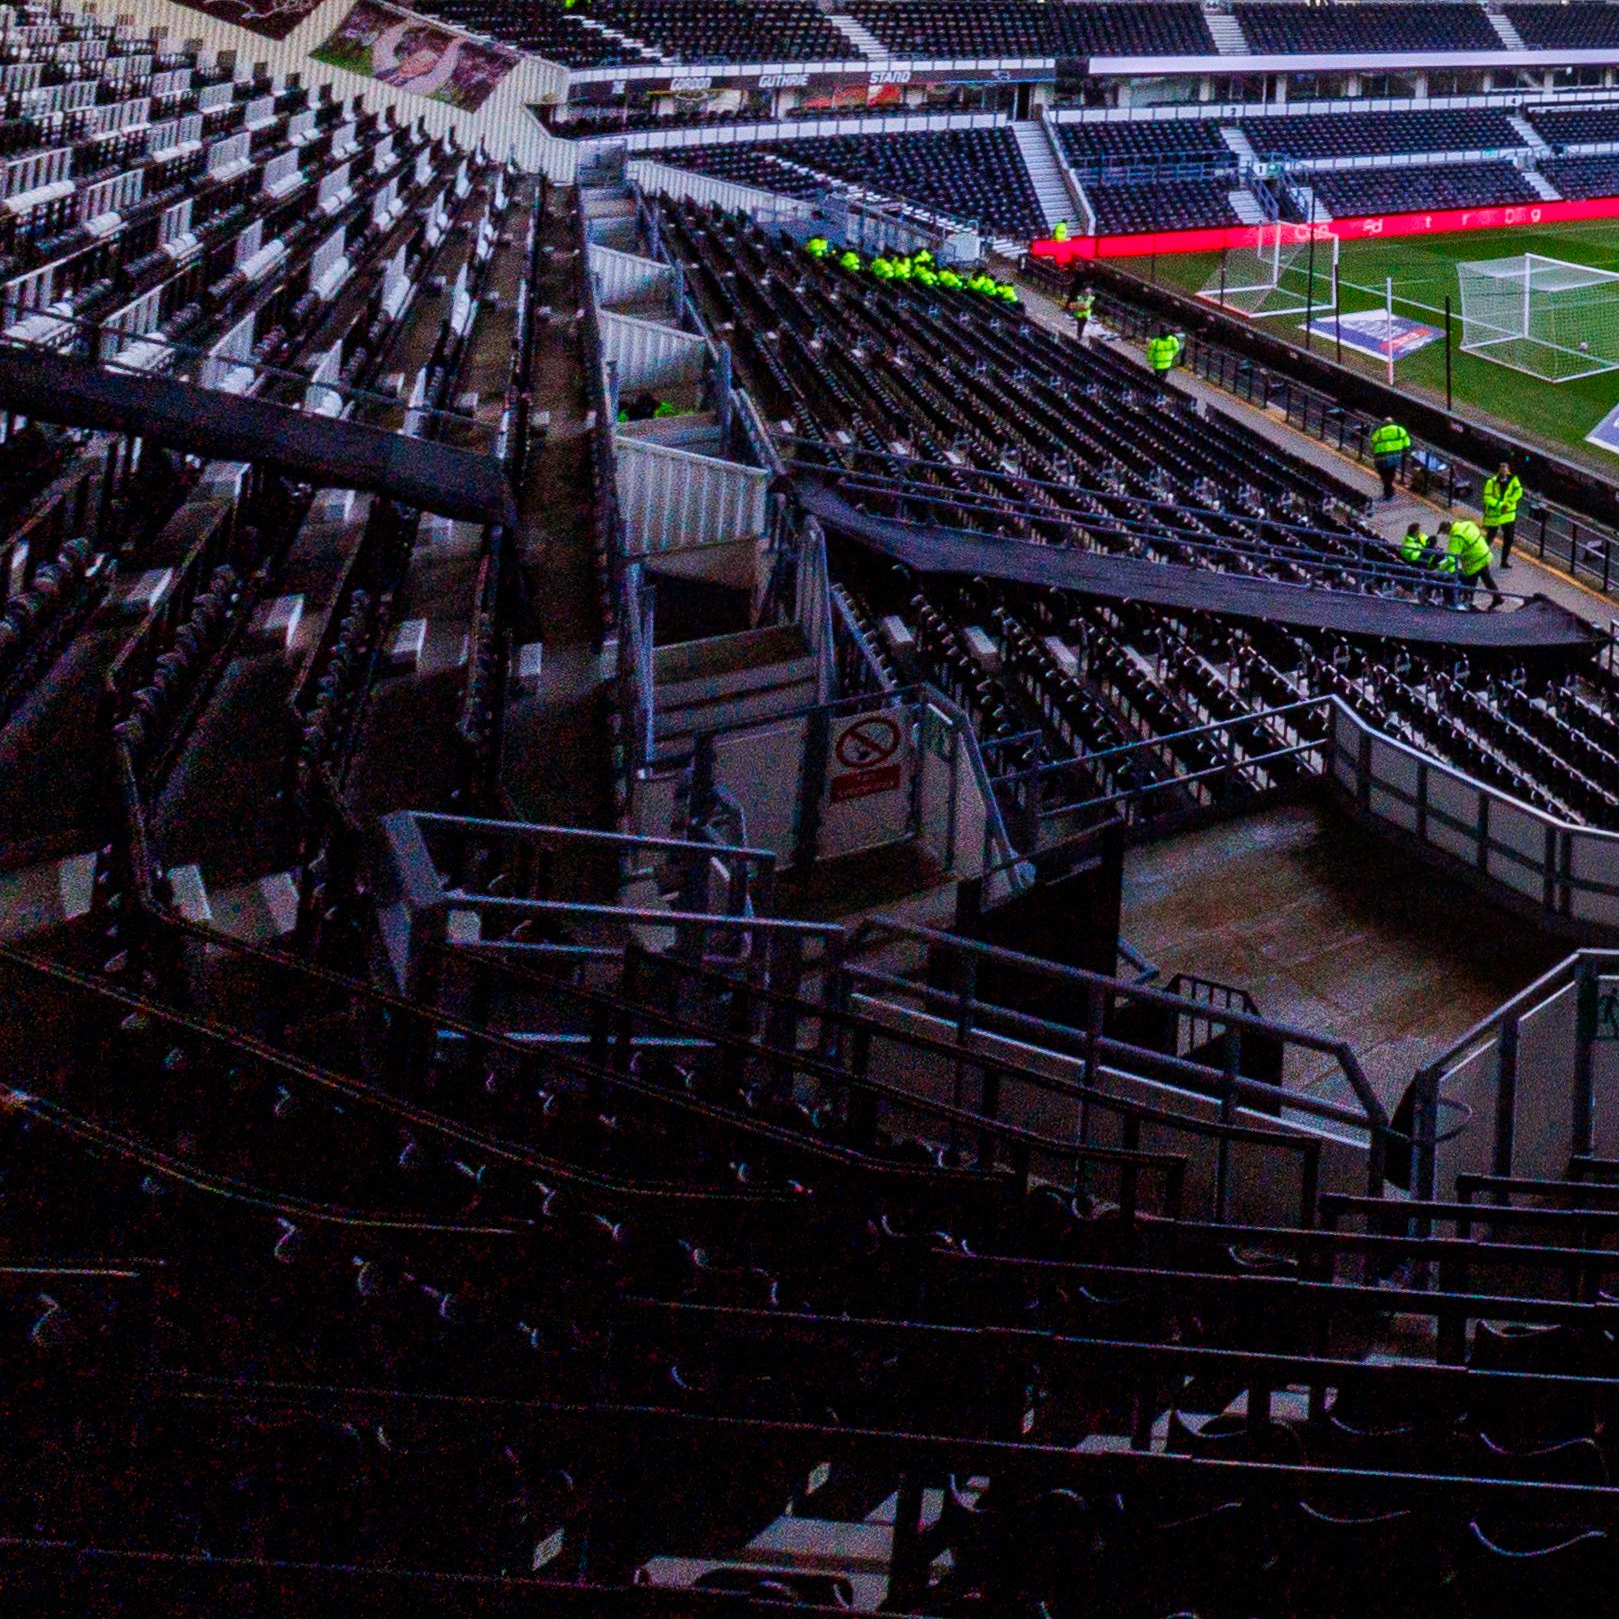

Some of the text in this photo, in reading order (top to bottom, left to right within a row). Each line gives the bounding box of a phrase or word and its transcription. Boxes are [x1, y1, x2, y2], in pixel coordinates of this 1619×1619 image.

[670, 71, 911, 90] GORDON GUTHRIE STAND
